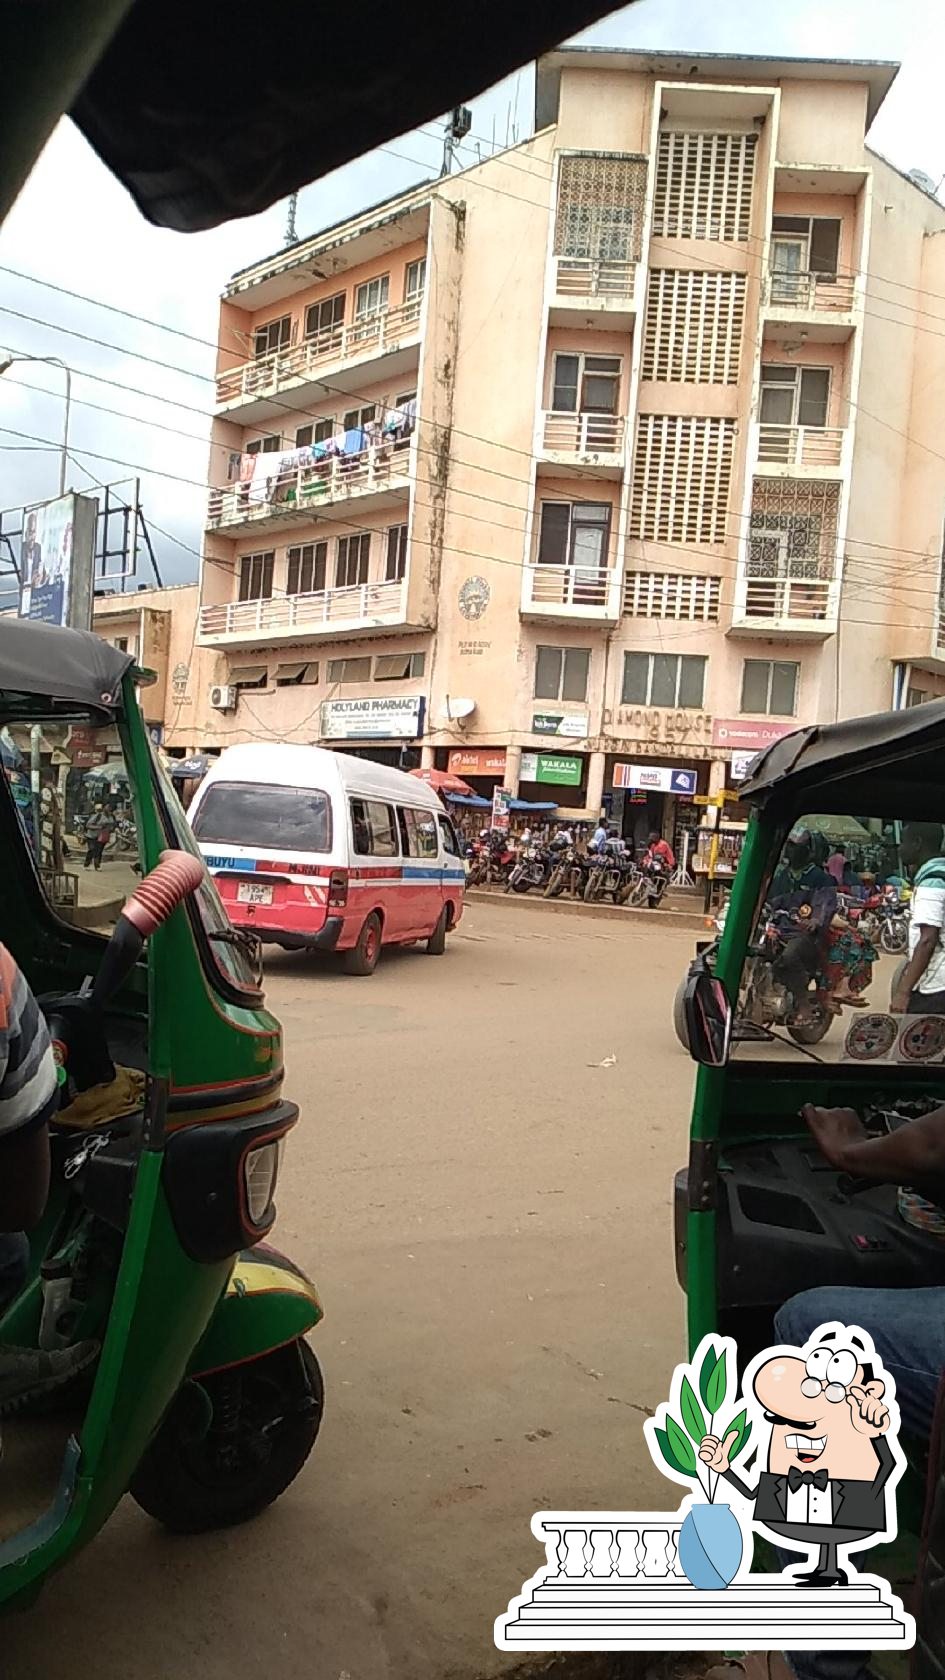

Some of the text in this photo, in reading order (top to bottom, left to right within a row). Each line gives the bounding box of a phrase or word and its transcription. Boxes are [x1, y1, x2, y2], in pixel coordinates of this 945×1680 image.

[331, 699, 418, 712] HOLYLAND PHARMACY
[541, 760, 577, 769] WAKALA
